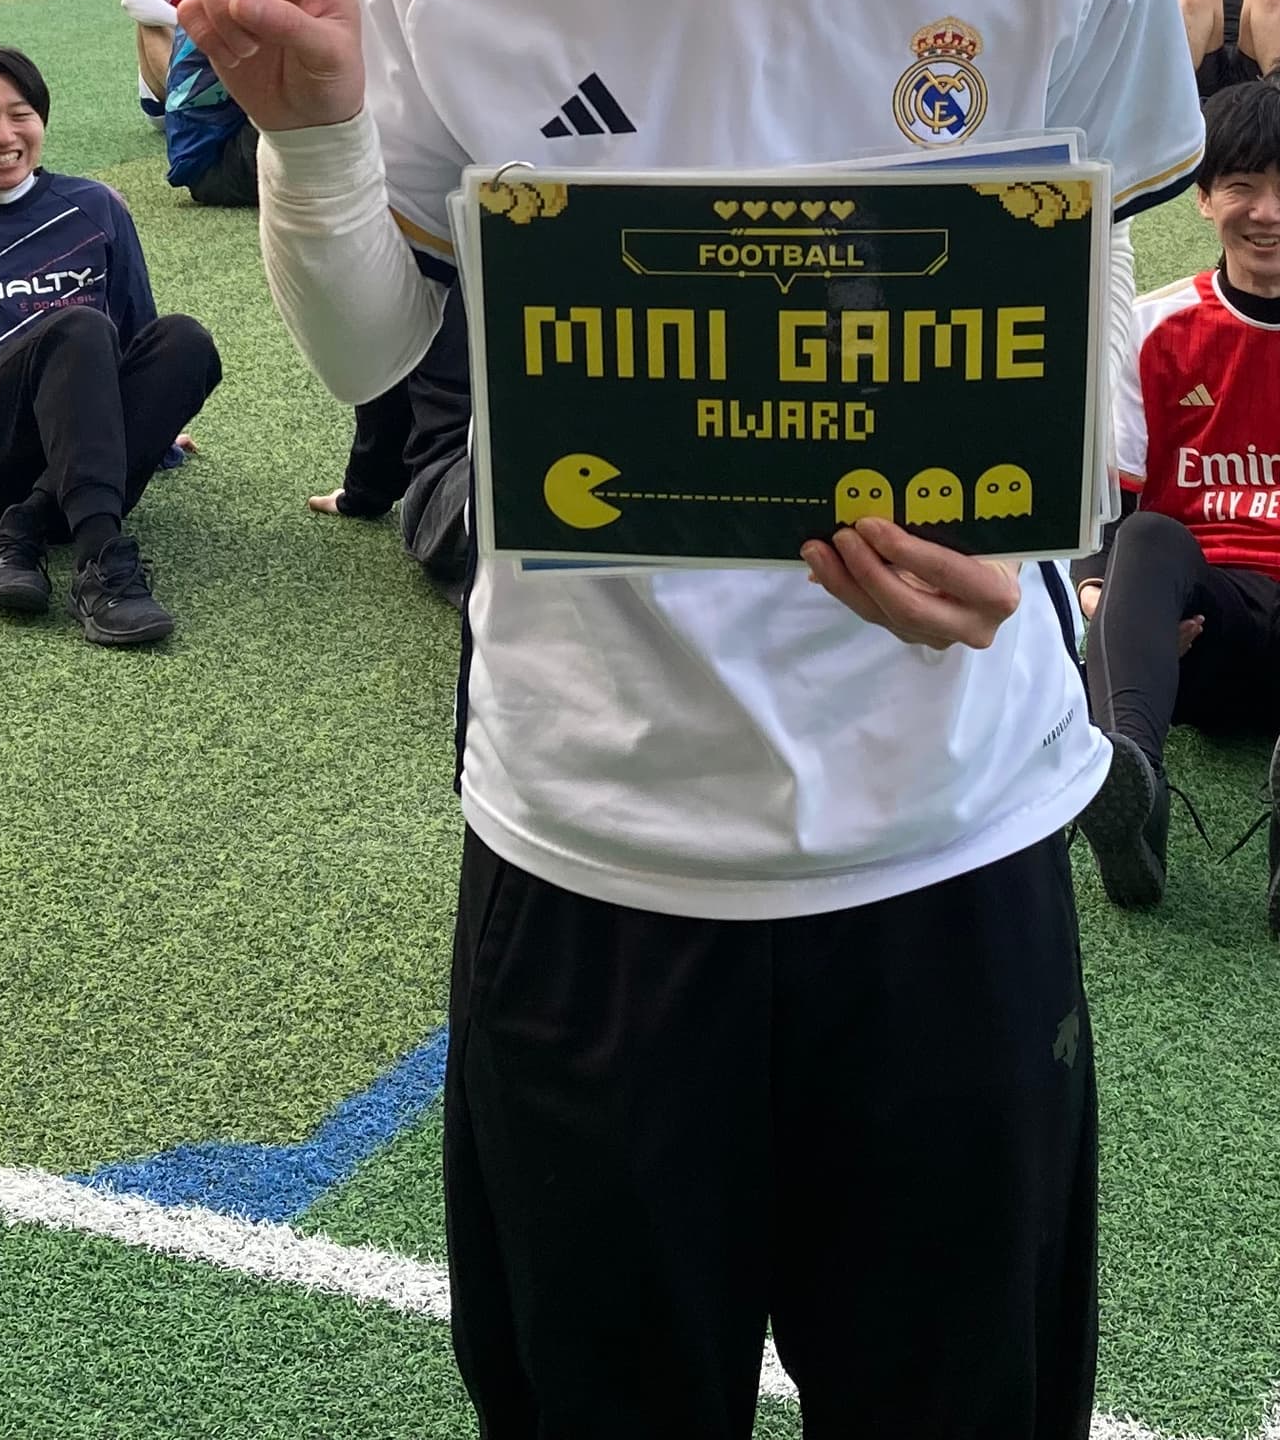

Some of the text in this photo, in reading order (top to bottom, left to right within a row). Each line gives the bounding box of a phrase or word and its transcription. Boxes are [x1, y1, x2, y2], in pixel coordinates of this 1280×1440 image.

[698, 243, 864, 268] FOOTBALL
[523, 305, 1046, 383] MINI GAME
[696, 398, 875, 441] AWARD
[1203, 491, 1244, 522] FLY
